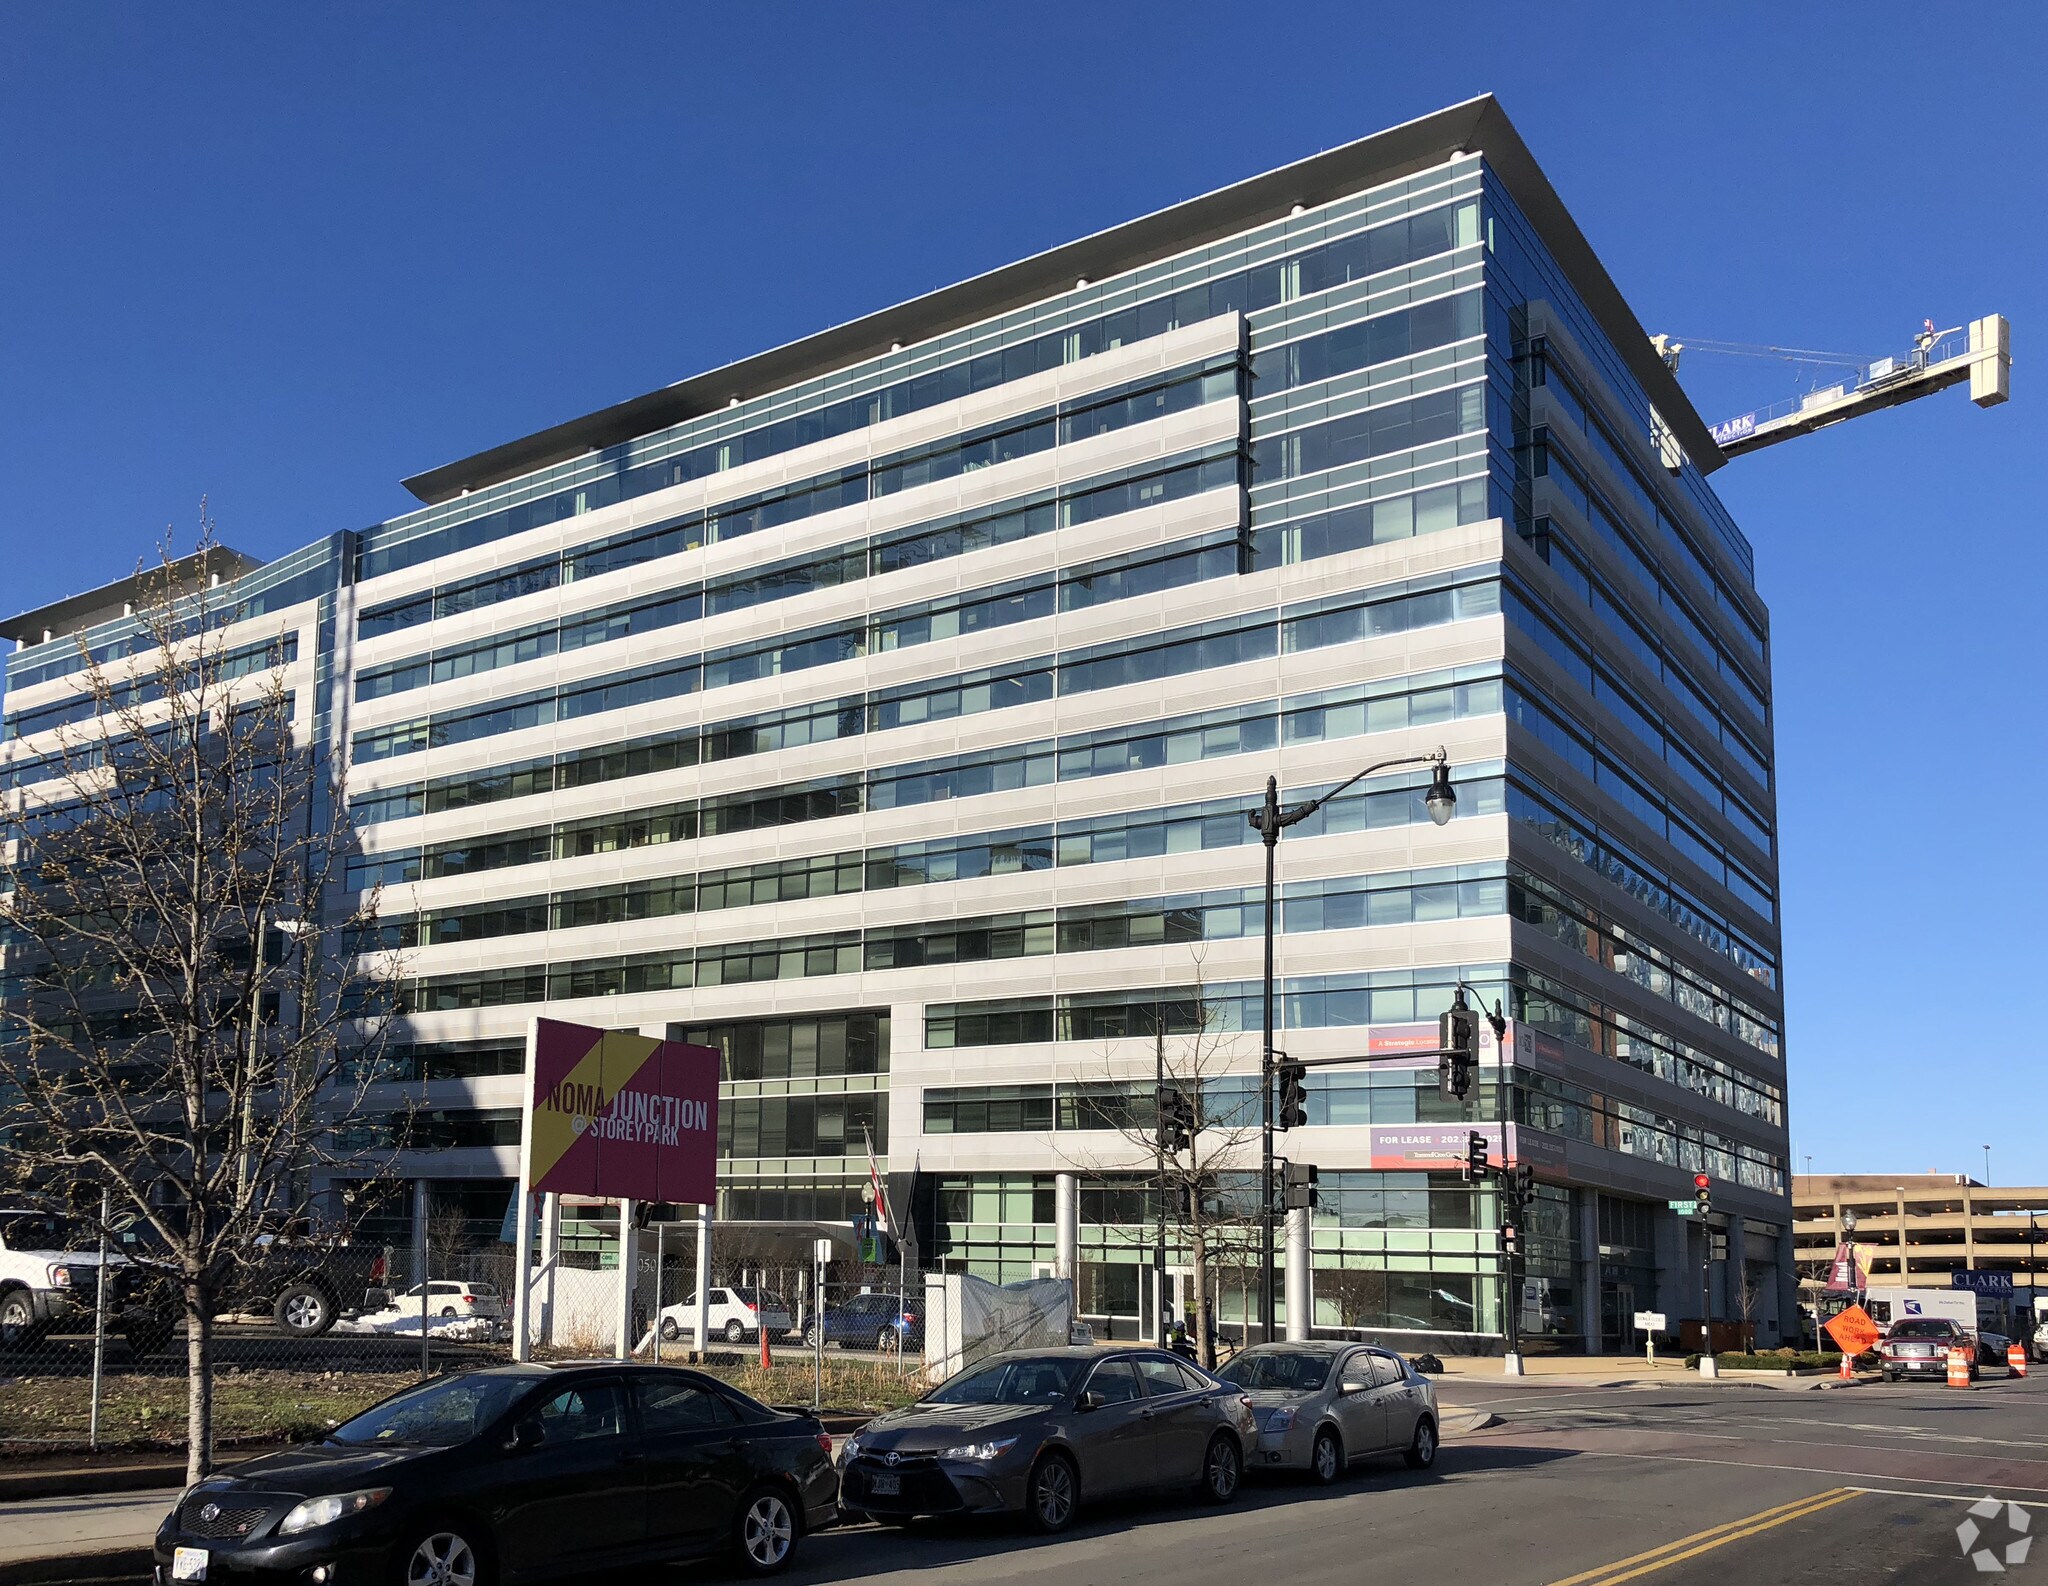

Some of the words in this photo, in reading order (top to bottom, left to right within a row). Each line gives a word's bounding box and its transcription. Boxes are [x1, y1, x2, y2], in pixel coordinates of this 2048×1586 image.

[1384, 1038, 1415, 1047] Strategic
[547, 1081, 606, 1117] NOMA
[610, 1089, 708, 1131] JUNCTION
[1380, 1136, 1398, 1144] FOR
[1401, 1135, 1432, 1144] LEASE
[1670, 1201, 1693, 1209] FIRST
[1953, 1273, 2012, 1288] CLARK
[1843, 1315, 1866, 1326] ROAD
[1842, 1324, 1865, 1336] WORK
[1839, 1333, 1867, 1345] AHEAD
